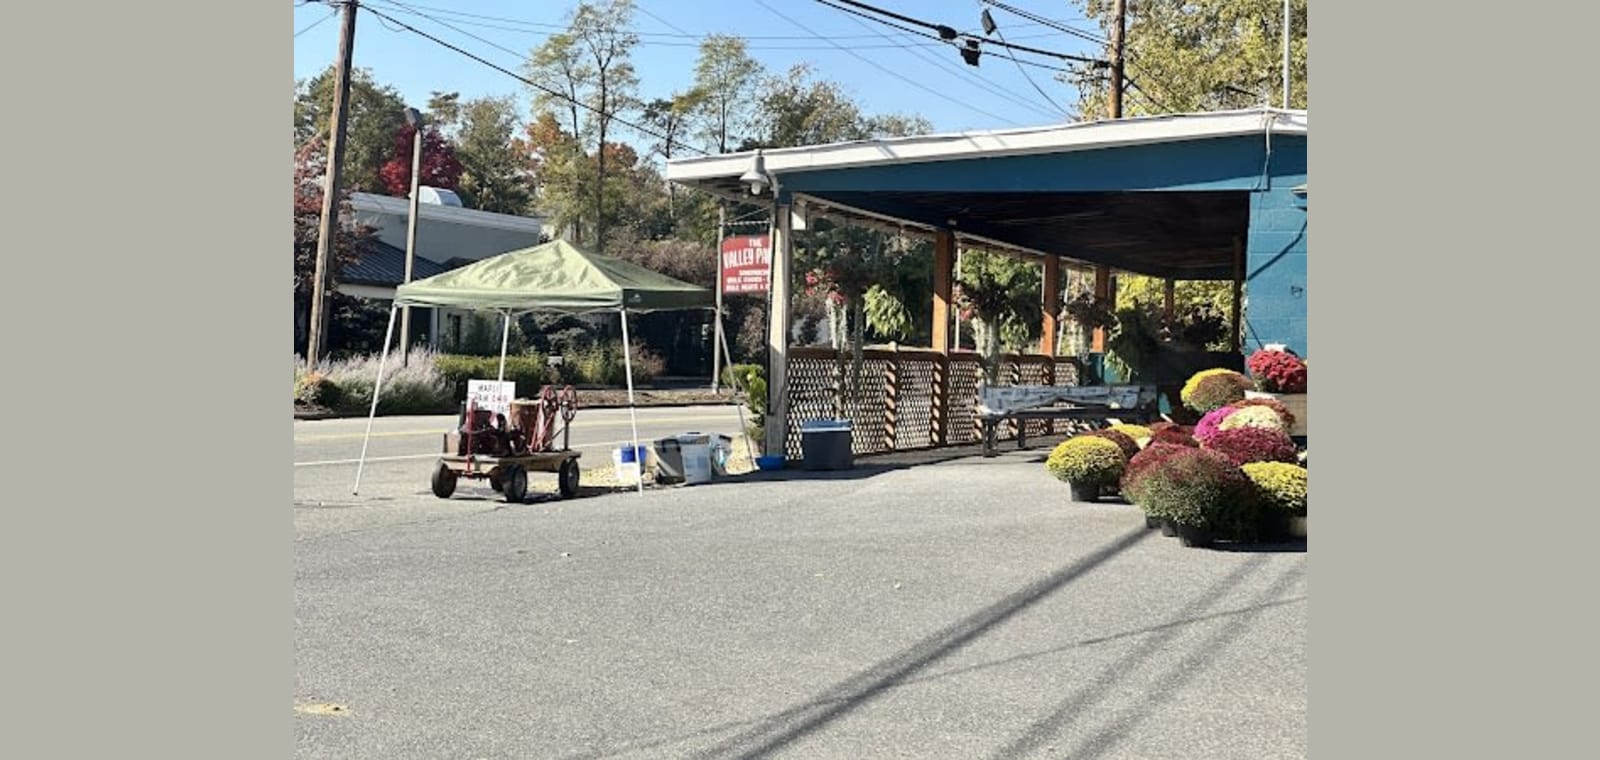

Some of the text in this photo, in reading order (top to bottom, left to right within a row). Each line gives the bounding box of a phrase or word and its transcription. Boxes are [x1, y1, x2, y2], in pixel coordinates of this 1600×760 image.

[749, 238, 762, 247] THE
[723, 247, 770, 269] VALLEY PA
